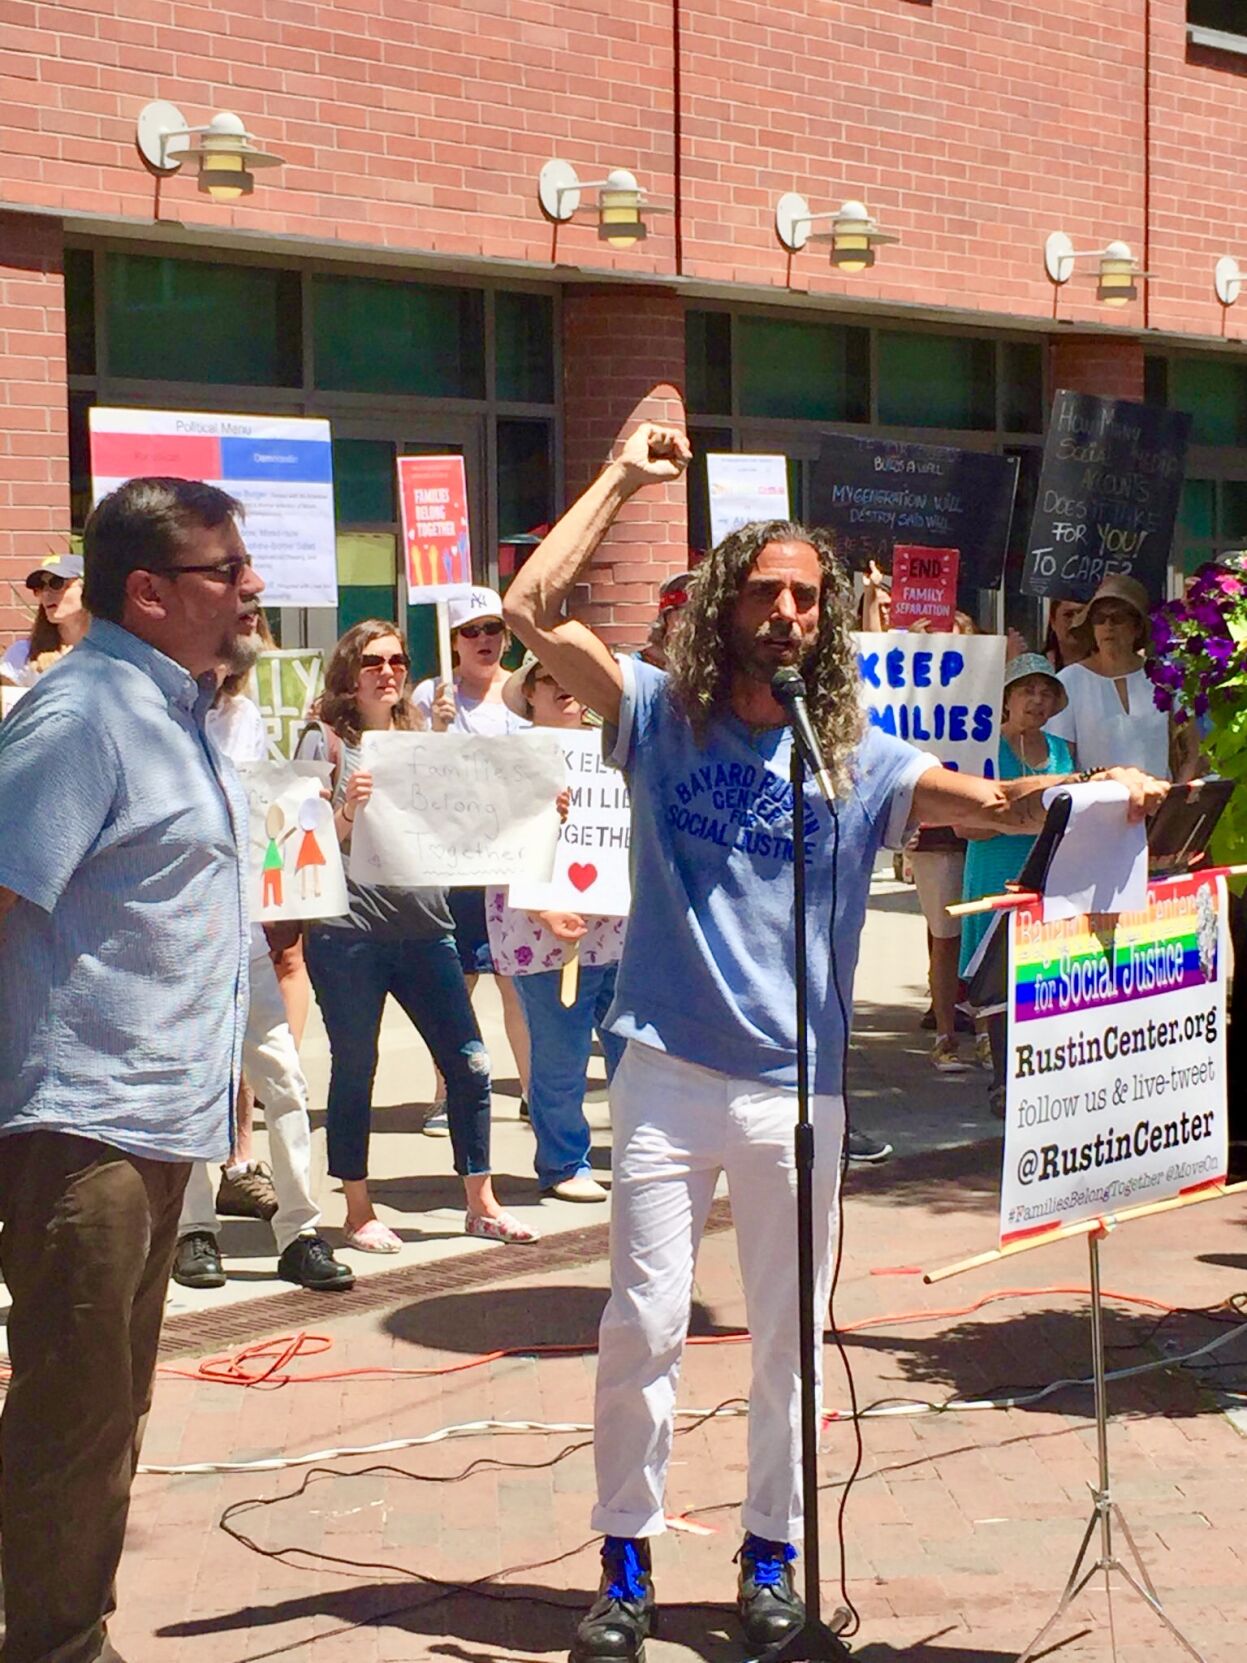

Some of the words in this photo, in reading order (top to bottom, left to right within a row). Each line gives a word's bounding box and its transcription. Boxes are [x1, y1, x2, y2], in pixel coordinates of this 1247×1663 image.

[176, 420, 218, 434] Political
[220, 423, 253, 436] Menu
[414, 488, 450, 504] FAMILIES
[832, 484, 853, 503] MY
[853, 487, 928, 510] GENERATION
[1043, 489, 1087, 518] DOES
[415, 505, 446, 521] BELONG
[850, 507, 895, 529] DESTROY
[416, 521, 456, 538] TOGETHER
[1051, 521, 1087, 545] FOR
[908, 558, 942, 580] END
[1031, 547, 1057, 577] TO
[1060, 554, 1133, 583] CARE?
[894, 601, 950, 617] SEPARATION
[902, 586, 945, 603] FAMILY
[857, 647, 965, 689] KEEP
[250, 657, 321, 719] LLY
[868, 703, 993, 742] MILIES
[411, 783, 500, 842] Belong
[675, 762, 757, 805] BAYARD
[757, 770, 820, 837] RUSIN
[665, 804, 728, 847] SOCIAL
[729, 809, 757, 828] FOR
[1033, 973, 1057, 1012] for
[1057, 950, 1118, 1010] Social
[1122, 937, 1185, 995] Justice
[1015, 1006, 1218, 1078] RustinCenter.org
[1017, 1091, 1080, 1129] follow
[1085, 1087, 1107, 1113] us
[1112, 1077, 1129, 1106] &
[1132, 1056, 1216, 1102] live-tweet
[1017, 1110, 1215, 1185] @RustinCenter
[1008, 1171, 1165, 1224] #FamiliesBelongTogether
[1165, 1154, 1218, 1183] @MoveOn
